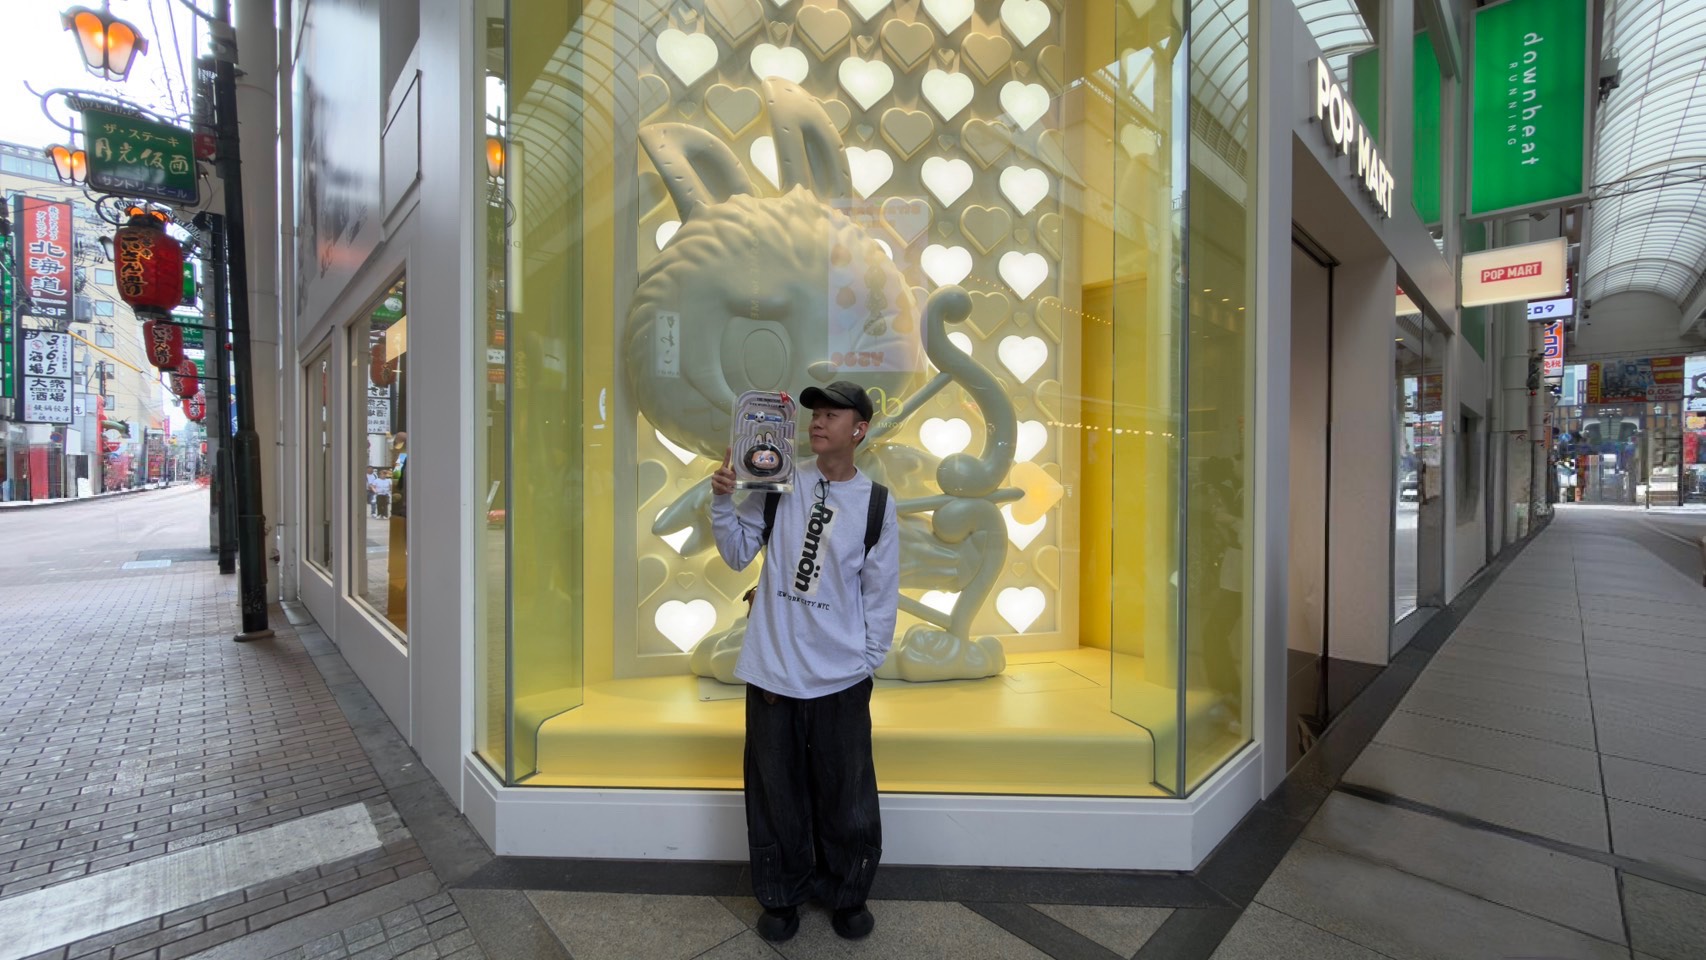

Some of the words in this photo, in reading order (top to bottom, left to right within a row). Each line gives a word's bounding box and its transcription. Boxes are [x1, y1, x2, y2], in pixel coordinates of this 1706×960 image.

[1507, 62, 1518, 145] RUNNING
[1521, 32, 1544, 165] downbeat
[1317, 57, 1354, 155] POP
[1358, 124, 1394, 218] MART
[95, 137, 189, 175] 月光仮面
[102, 175, 188, 199] サントリービール
[29, 240, 66, 295] 北海道
[1483, 270, 1505, 281] POP
[1507, 264, 1539, 277] MART
[31, 379, 66, 389] 大衆
[31, 391, 66, 402] 酒場
[801, 598, 816, 608] CITY
[817, 602, 830, 611] NYC
